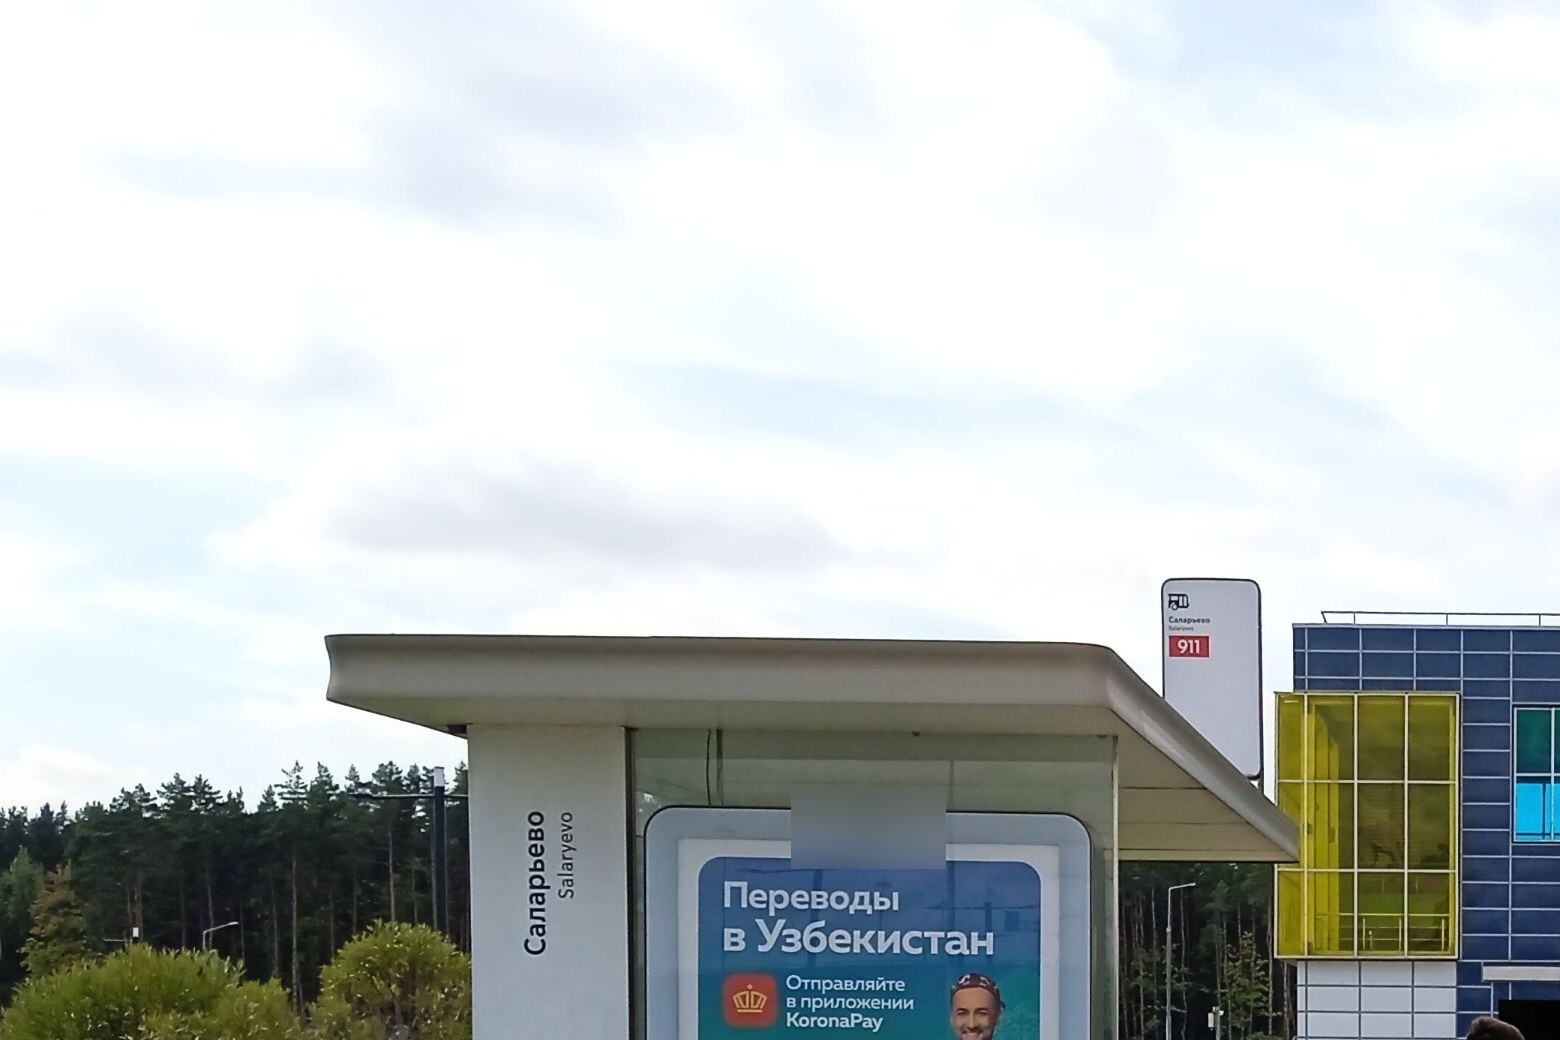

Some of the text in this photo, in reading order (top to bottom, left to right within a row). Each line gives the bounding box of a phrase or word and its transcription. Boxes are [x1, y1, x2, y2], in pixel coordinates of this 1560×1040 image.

[1168, 616, 1210, 624] Саларьево
[1178, 640, 1200, 654] 911
[556, 811, 578, 899] Salaryevo
[524, 810, 551, 956] Саларьево
[724, 881, 899, 916] Переводы
[724, 919, 994, 955] в Узбекистан
[786, 974, 905, 992] Отправляйте
[786, 997, 914, 1012] в приложении
[786, 1012, 883, 1032] KoronaPay
